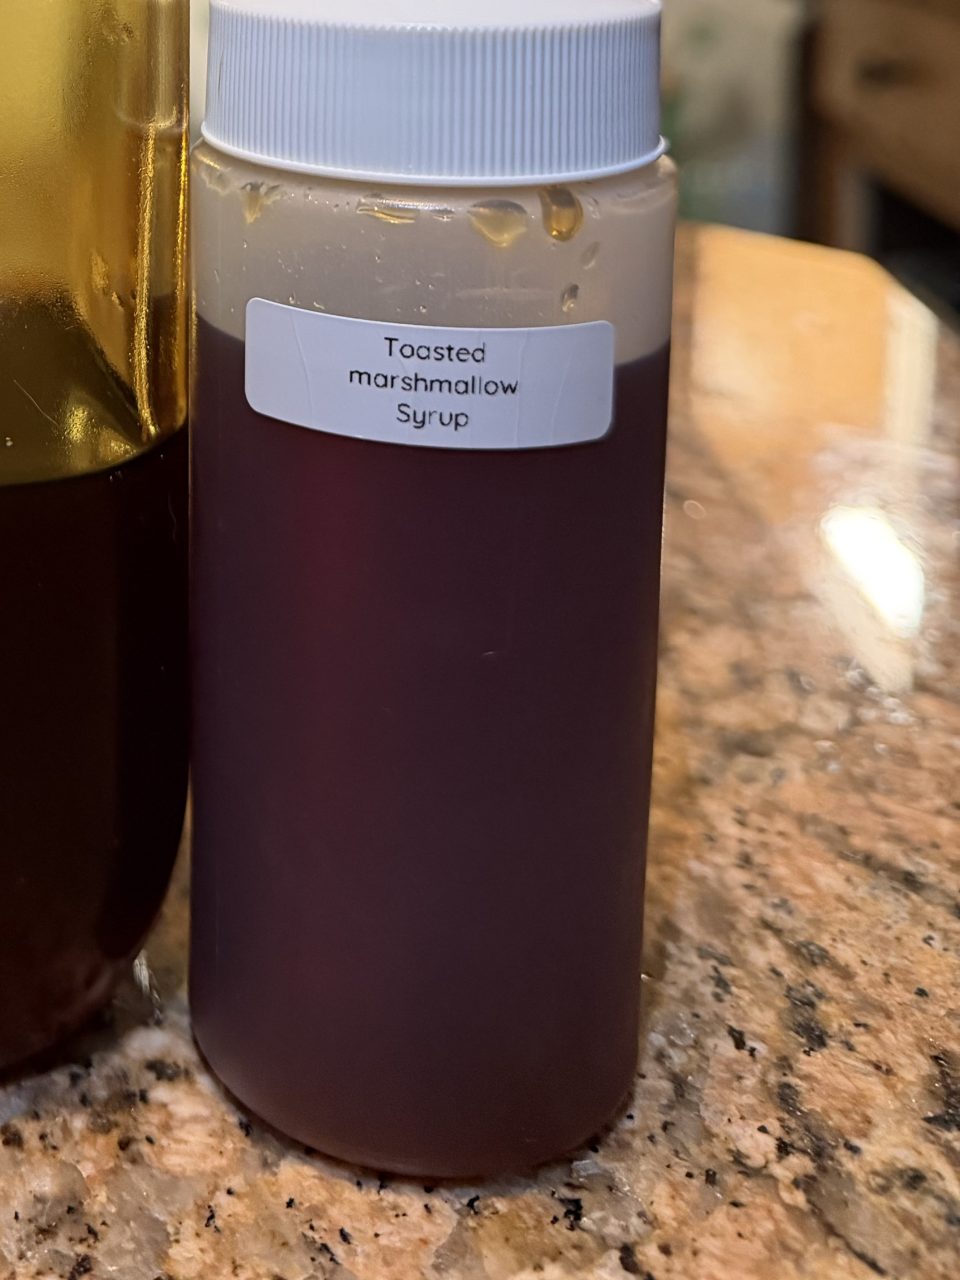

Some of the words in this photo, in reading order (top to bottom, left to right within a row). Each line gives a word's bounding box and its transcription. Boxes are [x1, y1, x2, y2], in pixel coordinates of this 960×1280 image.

[383, 336, 486, 364] Toasted
[349, 369, 519, 396] marshmallow
[396, 402, 470, 432] Syrup
